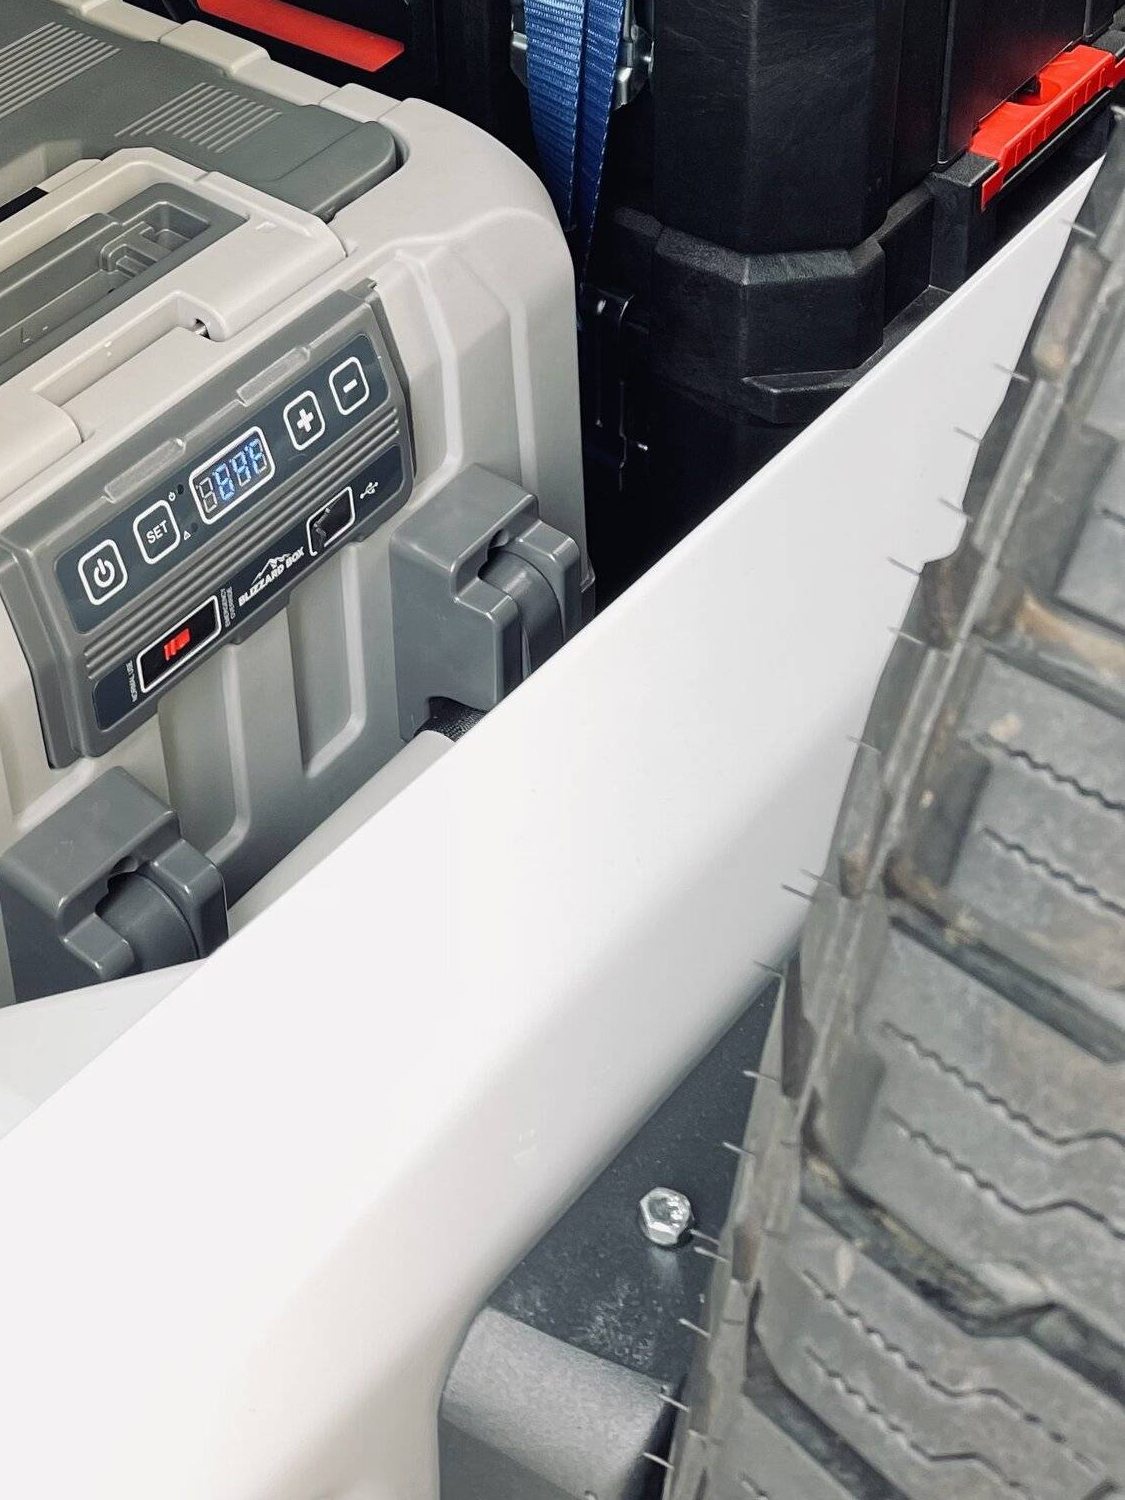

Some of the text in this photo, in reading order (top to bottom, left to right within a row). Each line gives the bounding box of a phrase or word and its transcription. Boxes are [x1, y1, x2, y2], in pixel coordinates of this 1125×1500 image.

[146, 520, 170, 545] SET
[238, 546, 305, 606] BLIZZARD BOX
